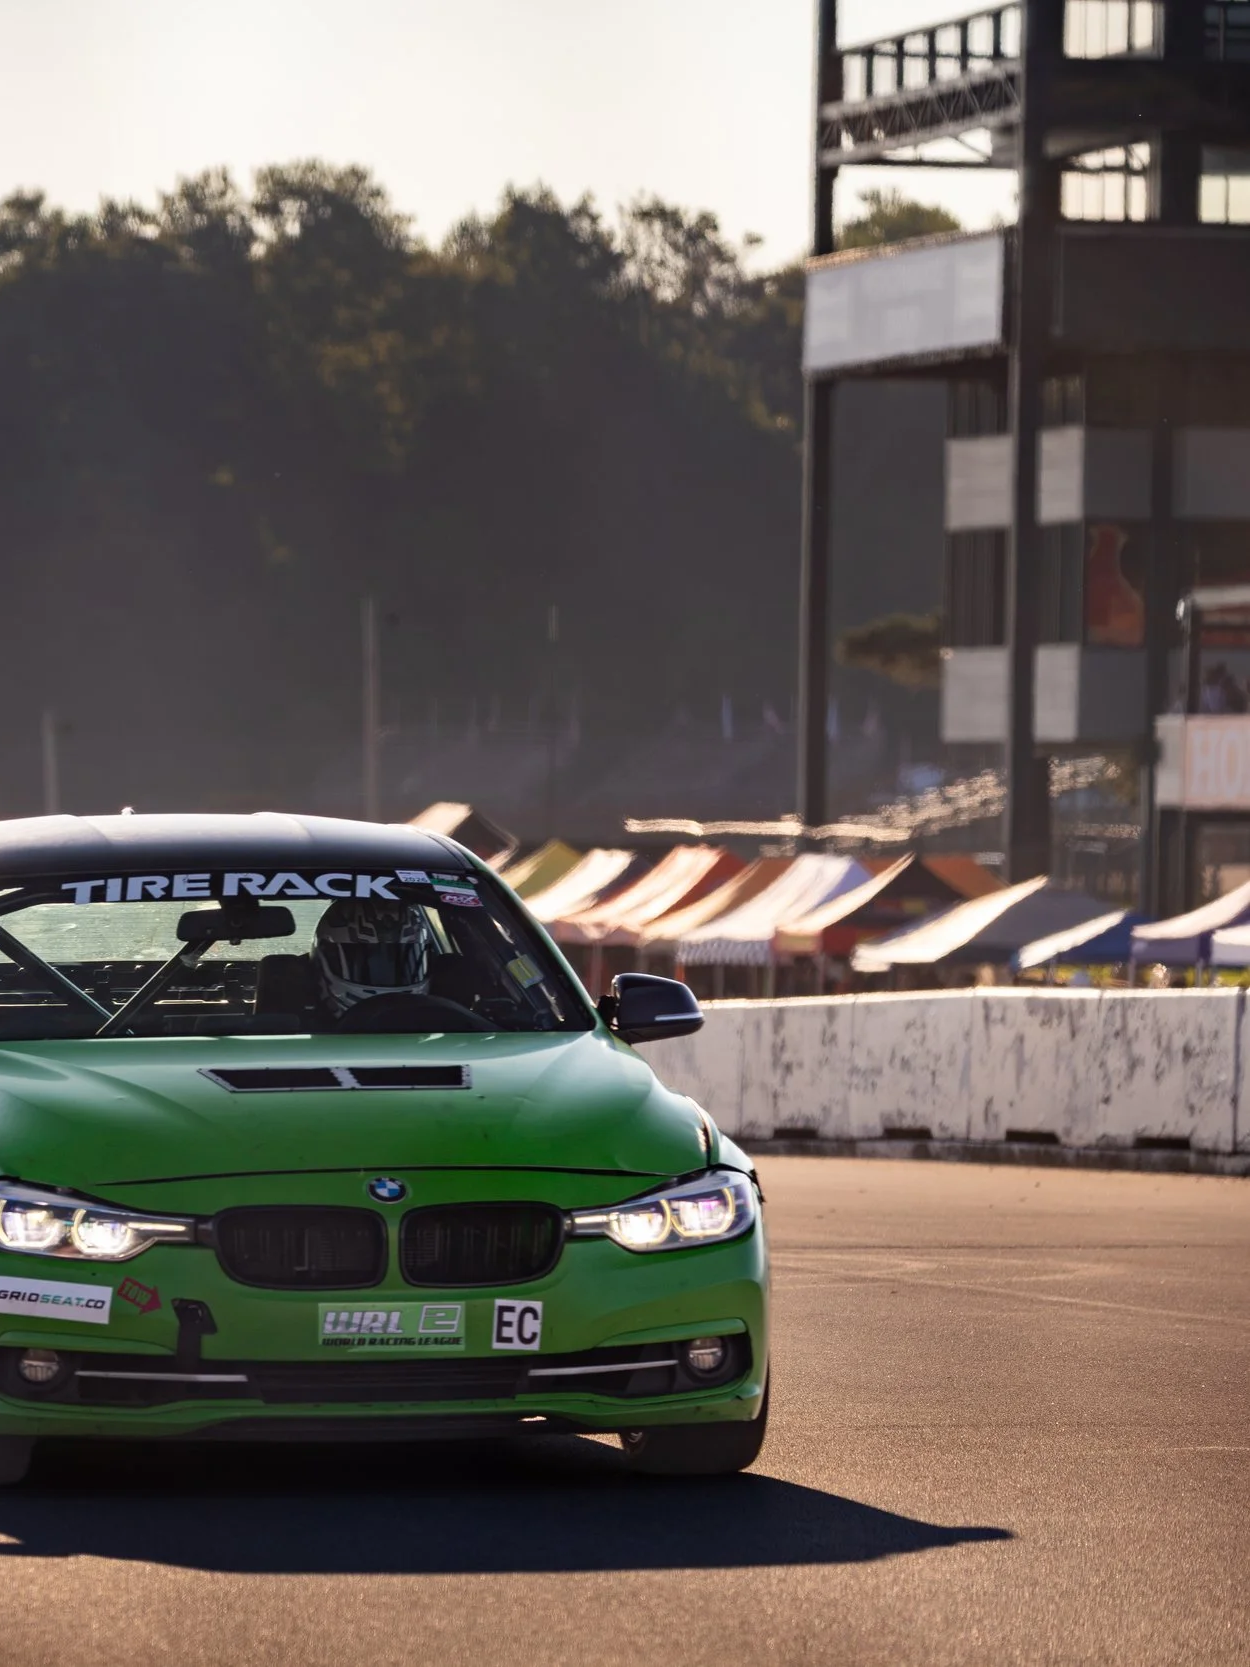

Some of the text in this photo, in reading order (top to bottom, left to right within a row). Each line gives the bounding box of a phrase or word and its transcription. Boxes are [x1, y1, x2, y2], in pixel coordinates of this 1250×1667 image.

[61, 872, 400, 905] TIRE RACK
[322, 1311, 403, 1334] WRL
[495, 1305, 540, 1345] EC
[321, 1337, 463, 1347] WORLD RACING LEAGUE
